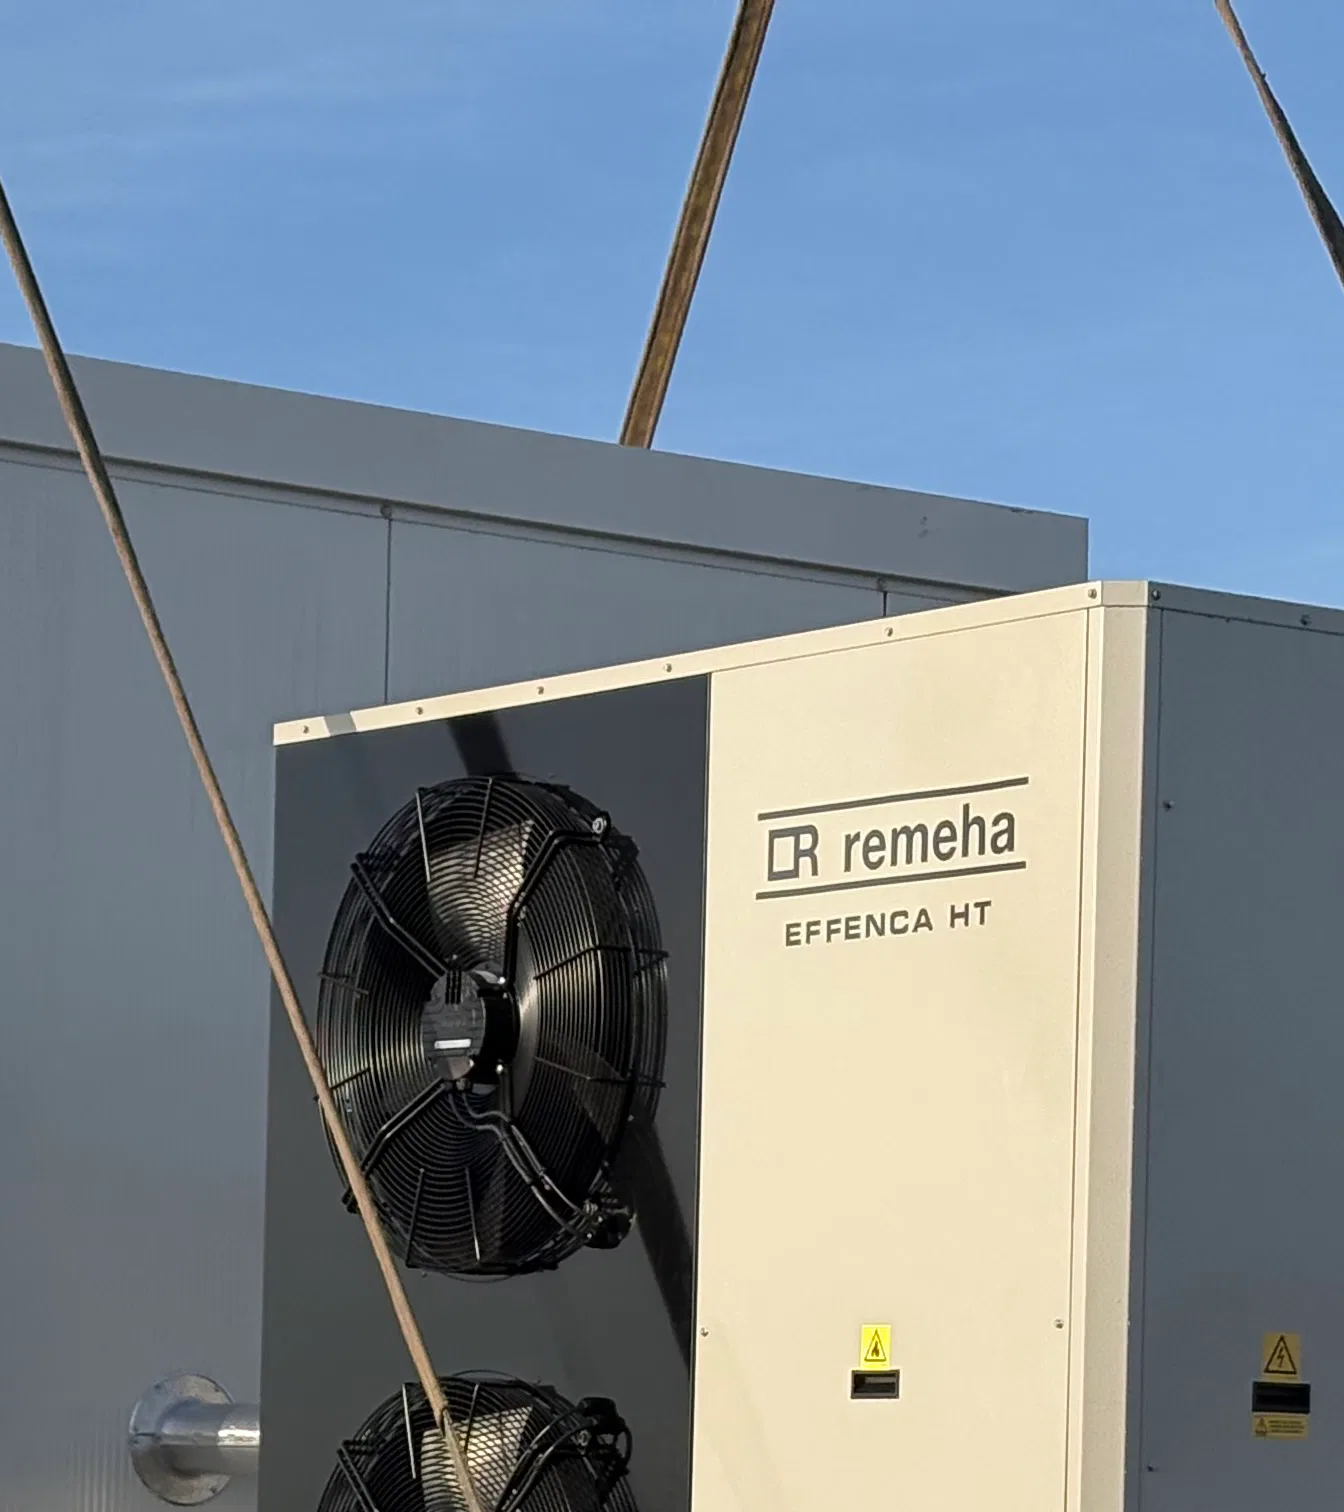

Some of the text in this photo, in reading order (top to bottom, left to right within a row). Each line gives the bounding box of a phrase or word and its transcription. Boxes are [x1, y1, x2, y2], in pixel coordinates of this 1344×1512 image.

[843, 802, 1015, 872] remeha
[785, 899, 992, 947] EFFENCA HT
